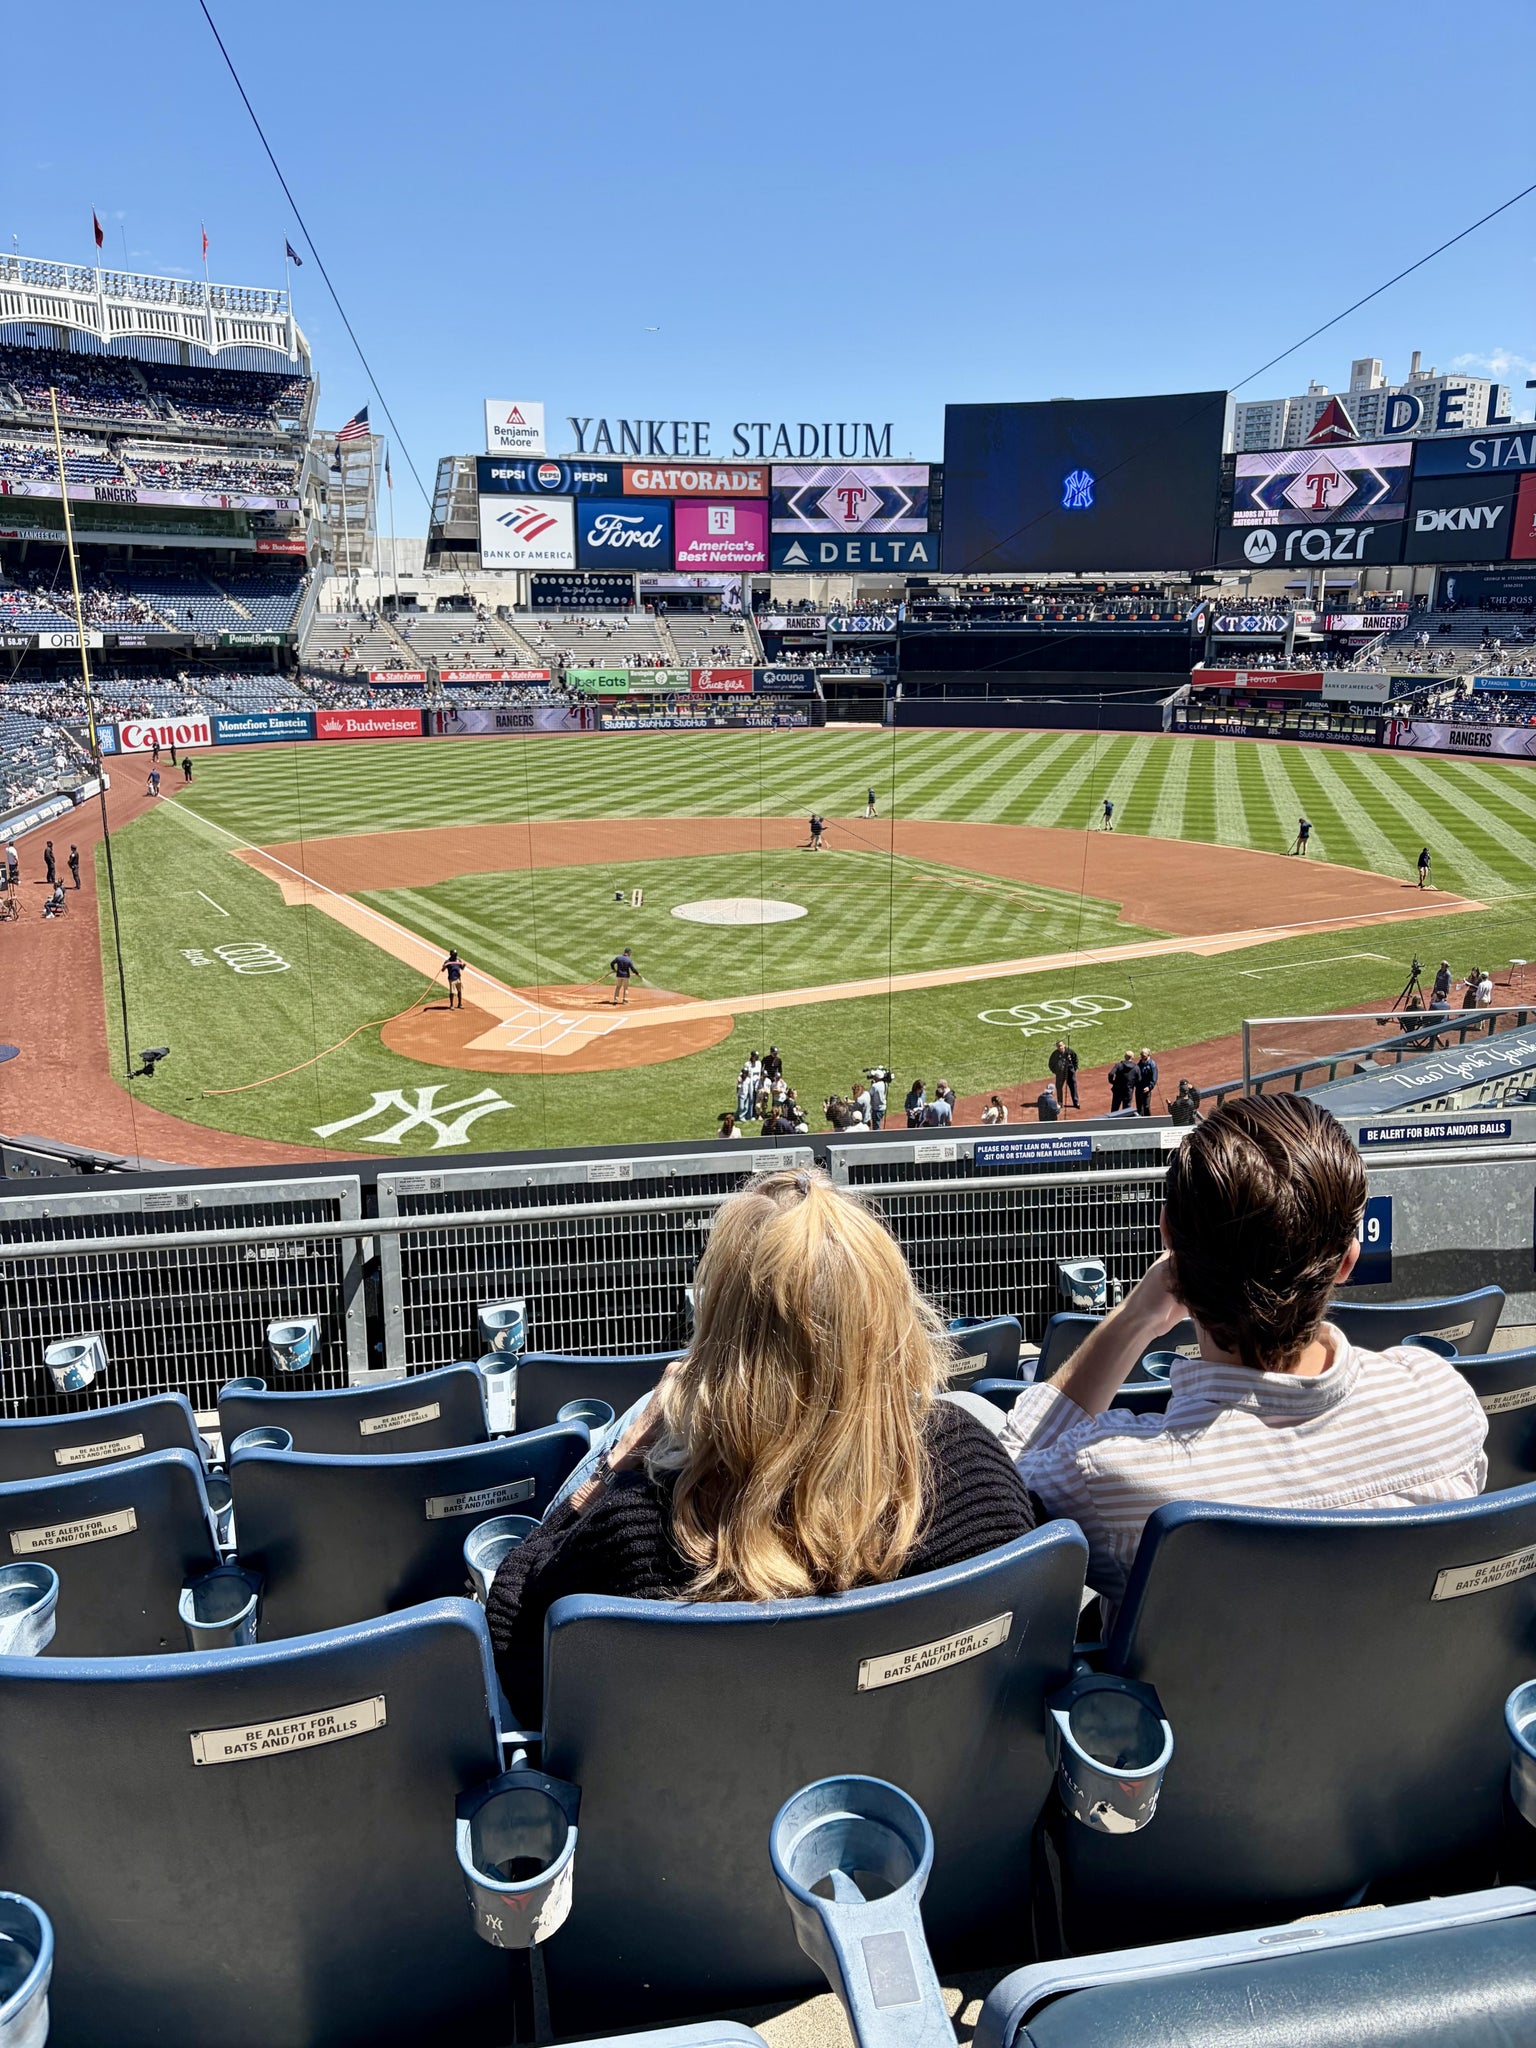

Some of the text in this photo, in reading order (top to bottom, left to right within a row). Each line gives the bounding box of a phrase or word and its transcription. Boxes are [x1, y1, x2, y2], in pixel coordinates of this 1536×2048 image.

[1384, 380, 1536, 434] DEL
[494, 425, 539, 438] Benjamin
[566, 417, 894, 458] YANKEE STADIUM
[500, 436, 532, 447] Moore
[491, 468, 525, 480] PEPSI
[574, 472, 608, 483] PEPSI
[631, 469, 762, 491] GATORADE
[94, 486, 289, 509] RANGERS TEX
[1415, 506, 1505, 532] DKNY
[20, 531, 49, 540] YANKEES
[586, 513, 663, 548] Ford
[688, 540, 755, 551] America's
[1284, 526, 1375, 562] razr
[484, 550, 573, 560] BANK OF AMERICA
[678, 552, 766, 562] Best Network
[820, 541, 929, 564] DELTA
[786, 618, 820, 628] RANGERS
[1362, 616, 1403, 629] RANGERS
[50, 634, 91, 647] ORIS
[229, 634, 280, 645] Poland Spring
[598, 676, 626, 688] Eats
[776, 673, 805, 684] coupa
[218, 718, 307, 732] Montefiore Einstein
[496, 714, 534, 728] RANGERS
[604, 719, 707, 730] StubHub StubHub StubHub
[746, 718, 773, 726] STARR
[122, 724, 209, 748] Canon
[1219, 725, 1247, 735] STARR
[1298, 730, 1325, 740] StubHub
[1326, 732, 1350, 741] StubHub
[1352, 734, 1376, 743] StubHub
[1449, 730, 1492, 747] RANGERS
[1020, 1018, 1104, 1038] Audi
[1378, 1072, 1444, 1089] New
[1426, 1054, 1492, 1080] York
[1367, 1124, 1506, 1140] BE ALERT FOR BATS AND/OR BALLS
[1053, 1148, 1082, 1157] RAILINGS.
[1502, 1394, 1520, 1402] ALERT
[388, 1418, 410, 1428] AND/OR
[412, 1414, 428, 1422] BALLS
[87, 1450, 112, 1458] AND/OR
[112, 1444, 132, 1453] BALLS
[89, 1445, 107, 1453] ALERT
[444, 1492, 519, 1513] BATS AND/OR BALLS
[468, 1492, 492, 1502] ALERT
[32, 1524, 118, 1548] BATS AND/OR BALLS
[58, 1526, 84, 1536] ALERT
[1475, 1554, 1534, 1578] BE ALERT FOR
[1456, 1568, 1518, 1591] BATS AND/OR
[904, 1634, 974, 1665] BE ALERT FOR
[884, 1637, 989, 1680] BATS AND/OR BALLS
[246, 1716, 335, 1742] BE ALERT FOR
[224, 1720, 358, 1755] BATS AND/OR BALLS
